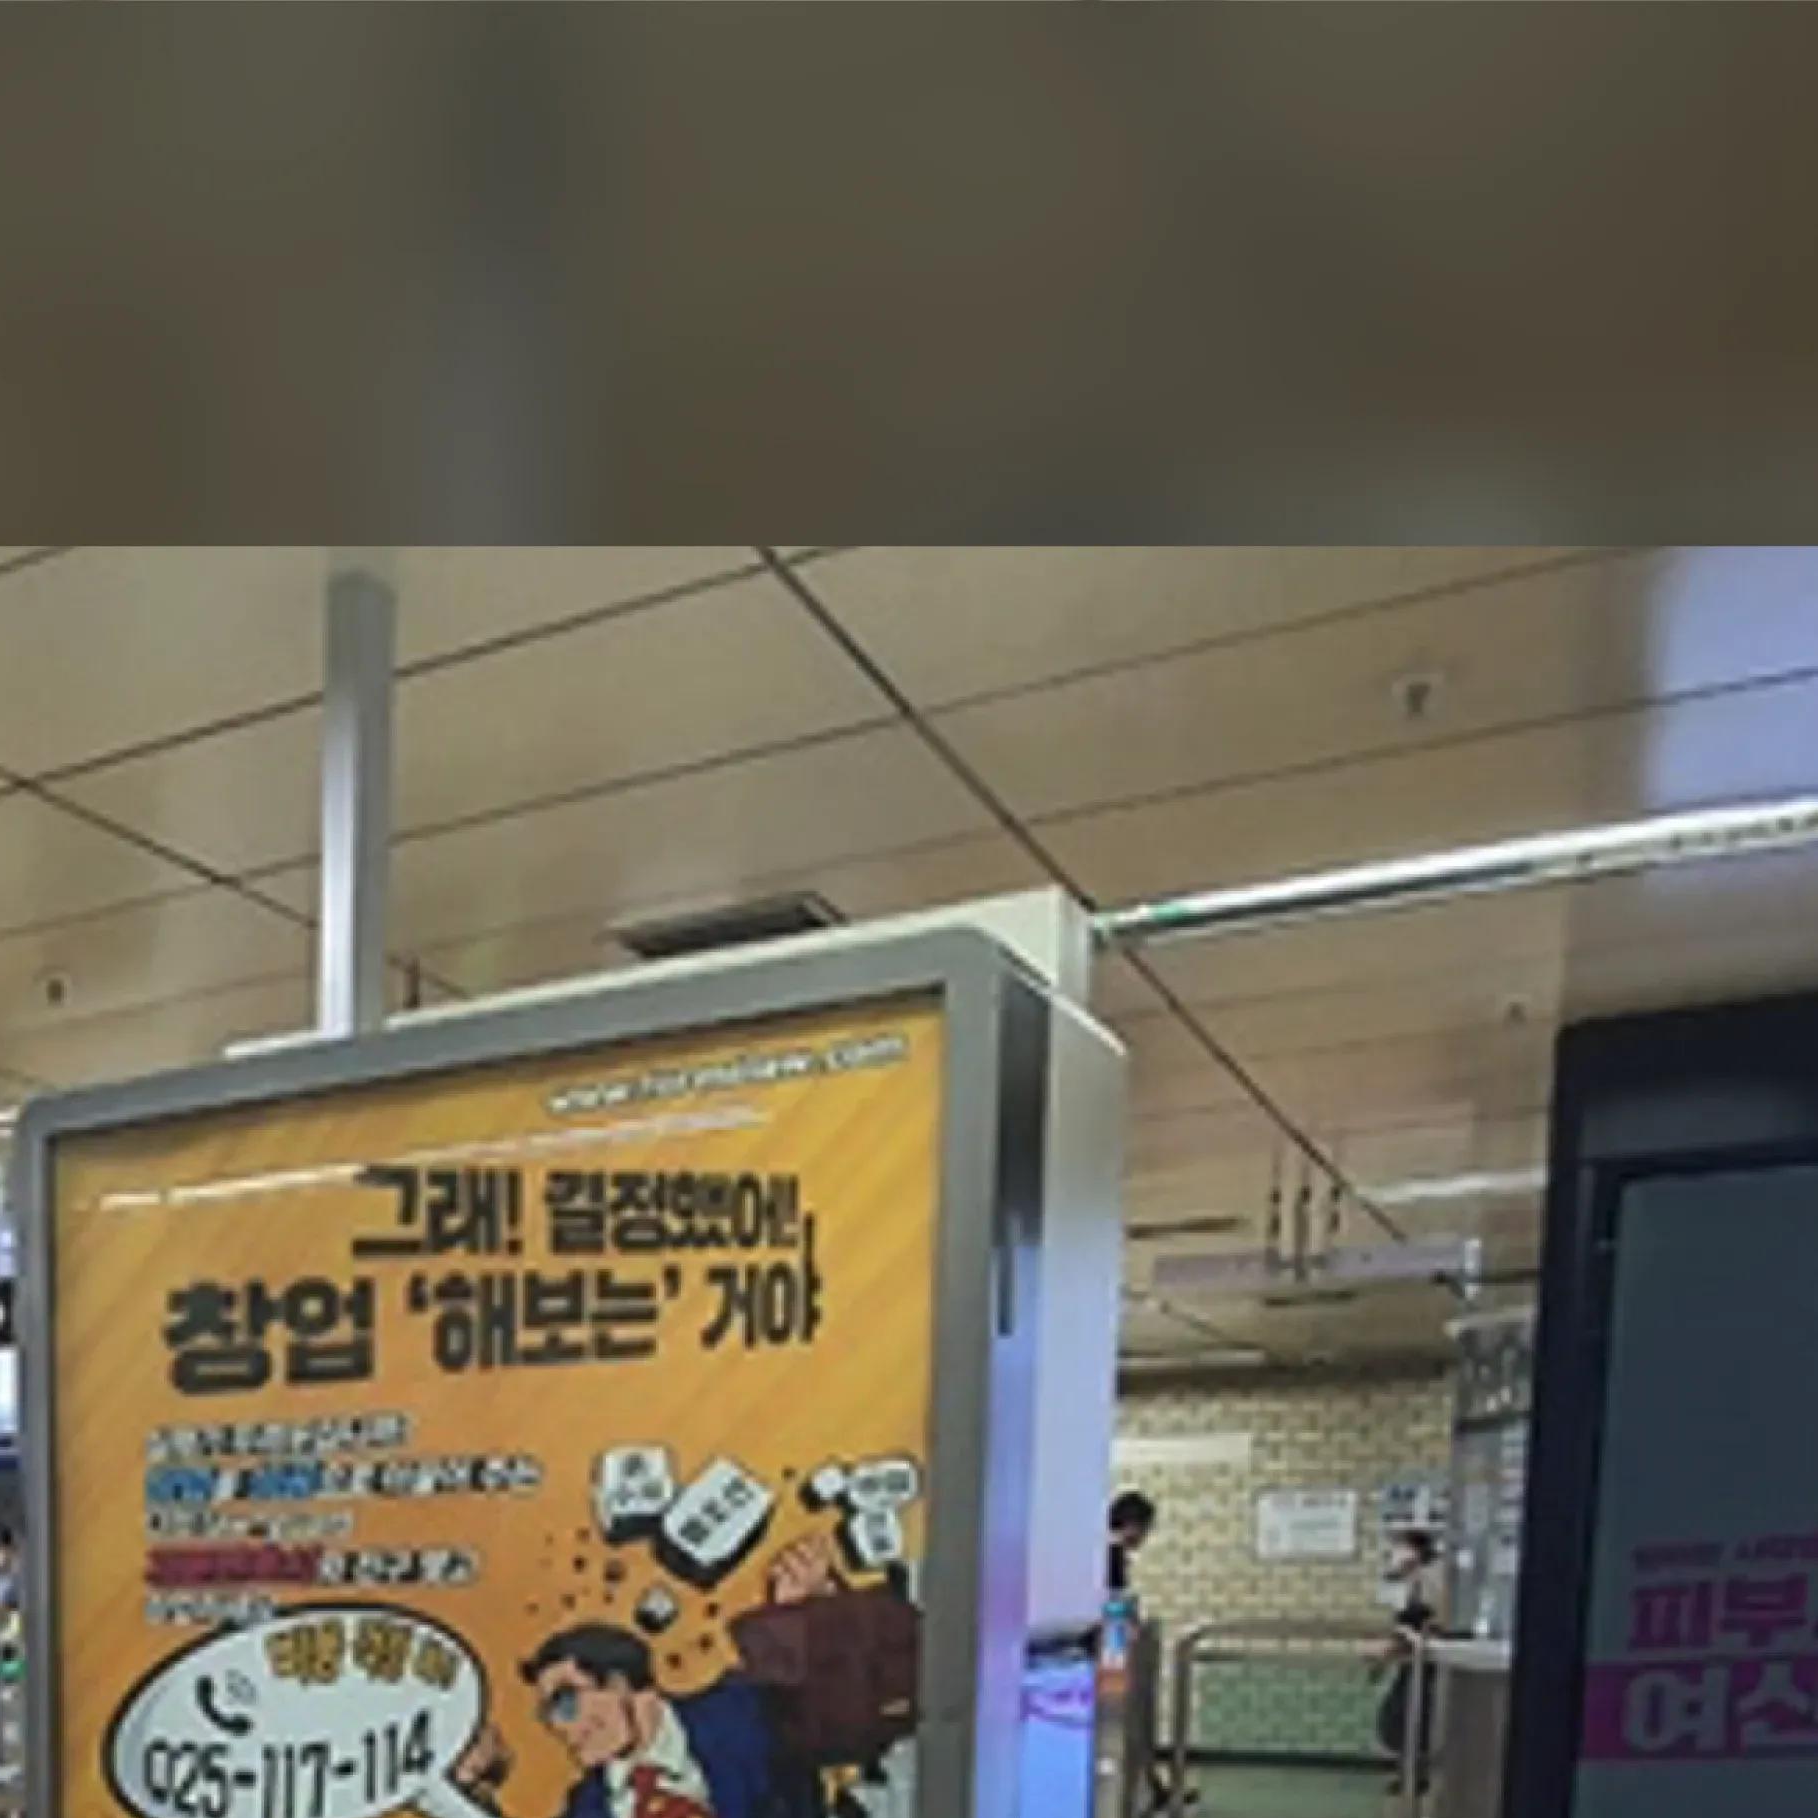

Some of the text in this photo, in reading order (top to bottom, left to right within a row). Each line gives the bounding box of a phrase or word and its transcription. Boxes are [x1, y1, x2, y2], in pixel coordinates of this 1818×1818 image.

[350, 1168, 524, 1258] 그래!
[163, 1276, 374, 1396] 창업
[701, 1210, 821, 1350] 거야
